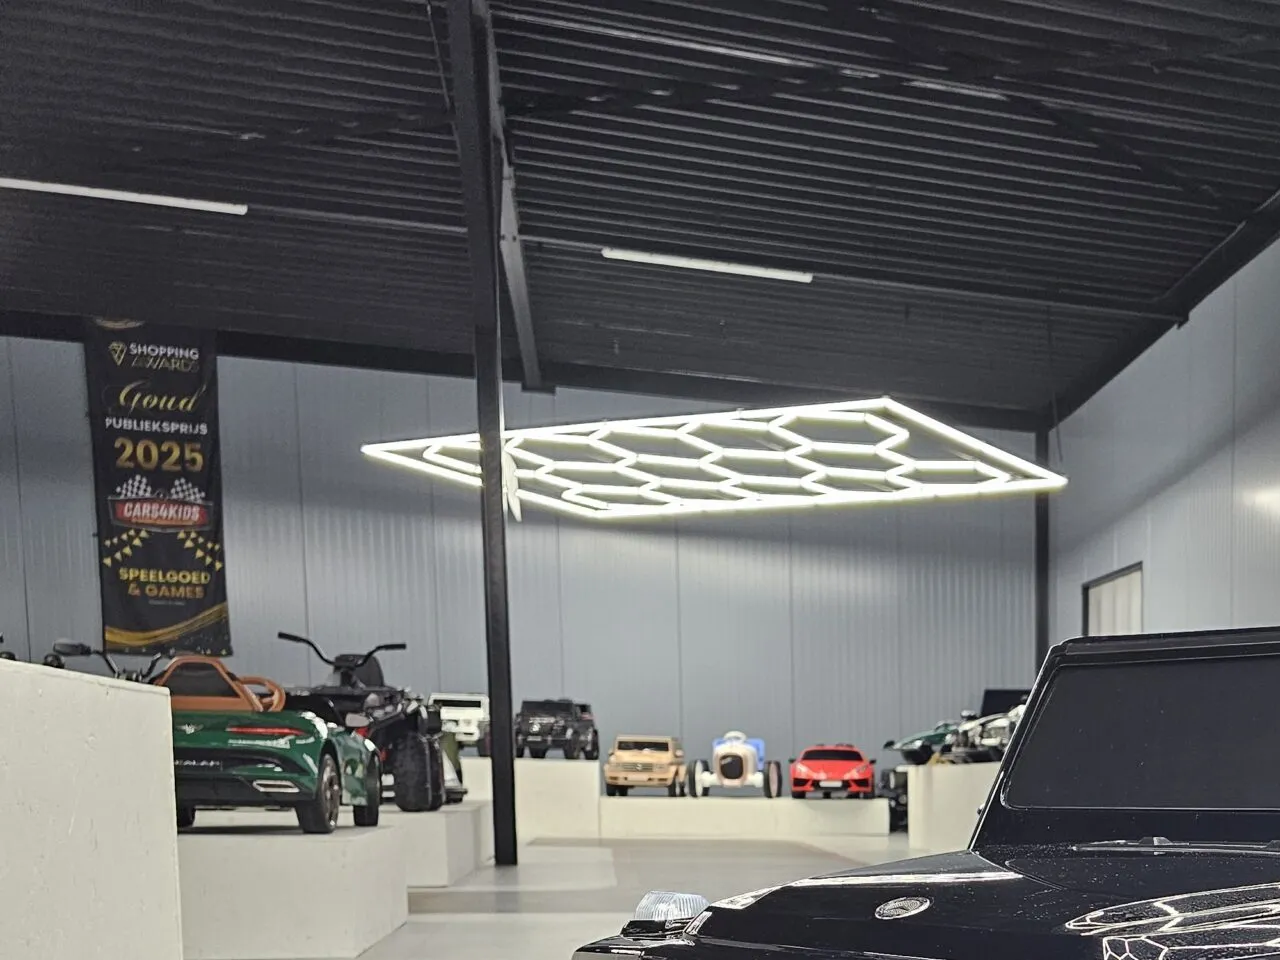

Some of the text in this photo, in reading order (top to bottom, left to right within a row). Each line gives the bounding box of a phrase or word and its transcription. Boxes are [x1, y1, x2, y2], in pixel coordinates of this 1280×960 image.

[129, 342, 200, 360] SHOPPING
[118, 379, 208, 415] Goud
[105, 416, 209, 435] PUBLIEKSPRIJS
[114, 437, 204, 472] 2025
[123, 501, 201, 521] CARS4KIDS
[118, 567, 211, 585] SPEELGOED
[145, 585, 205, 599] GAMES
